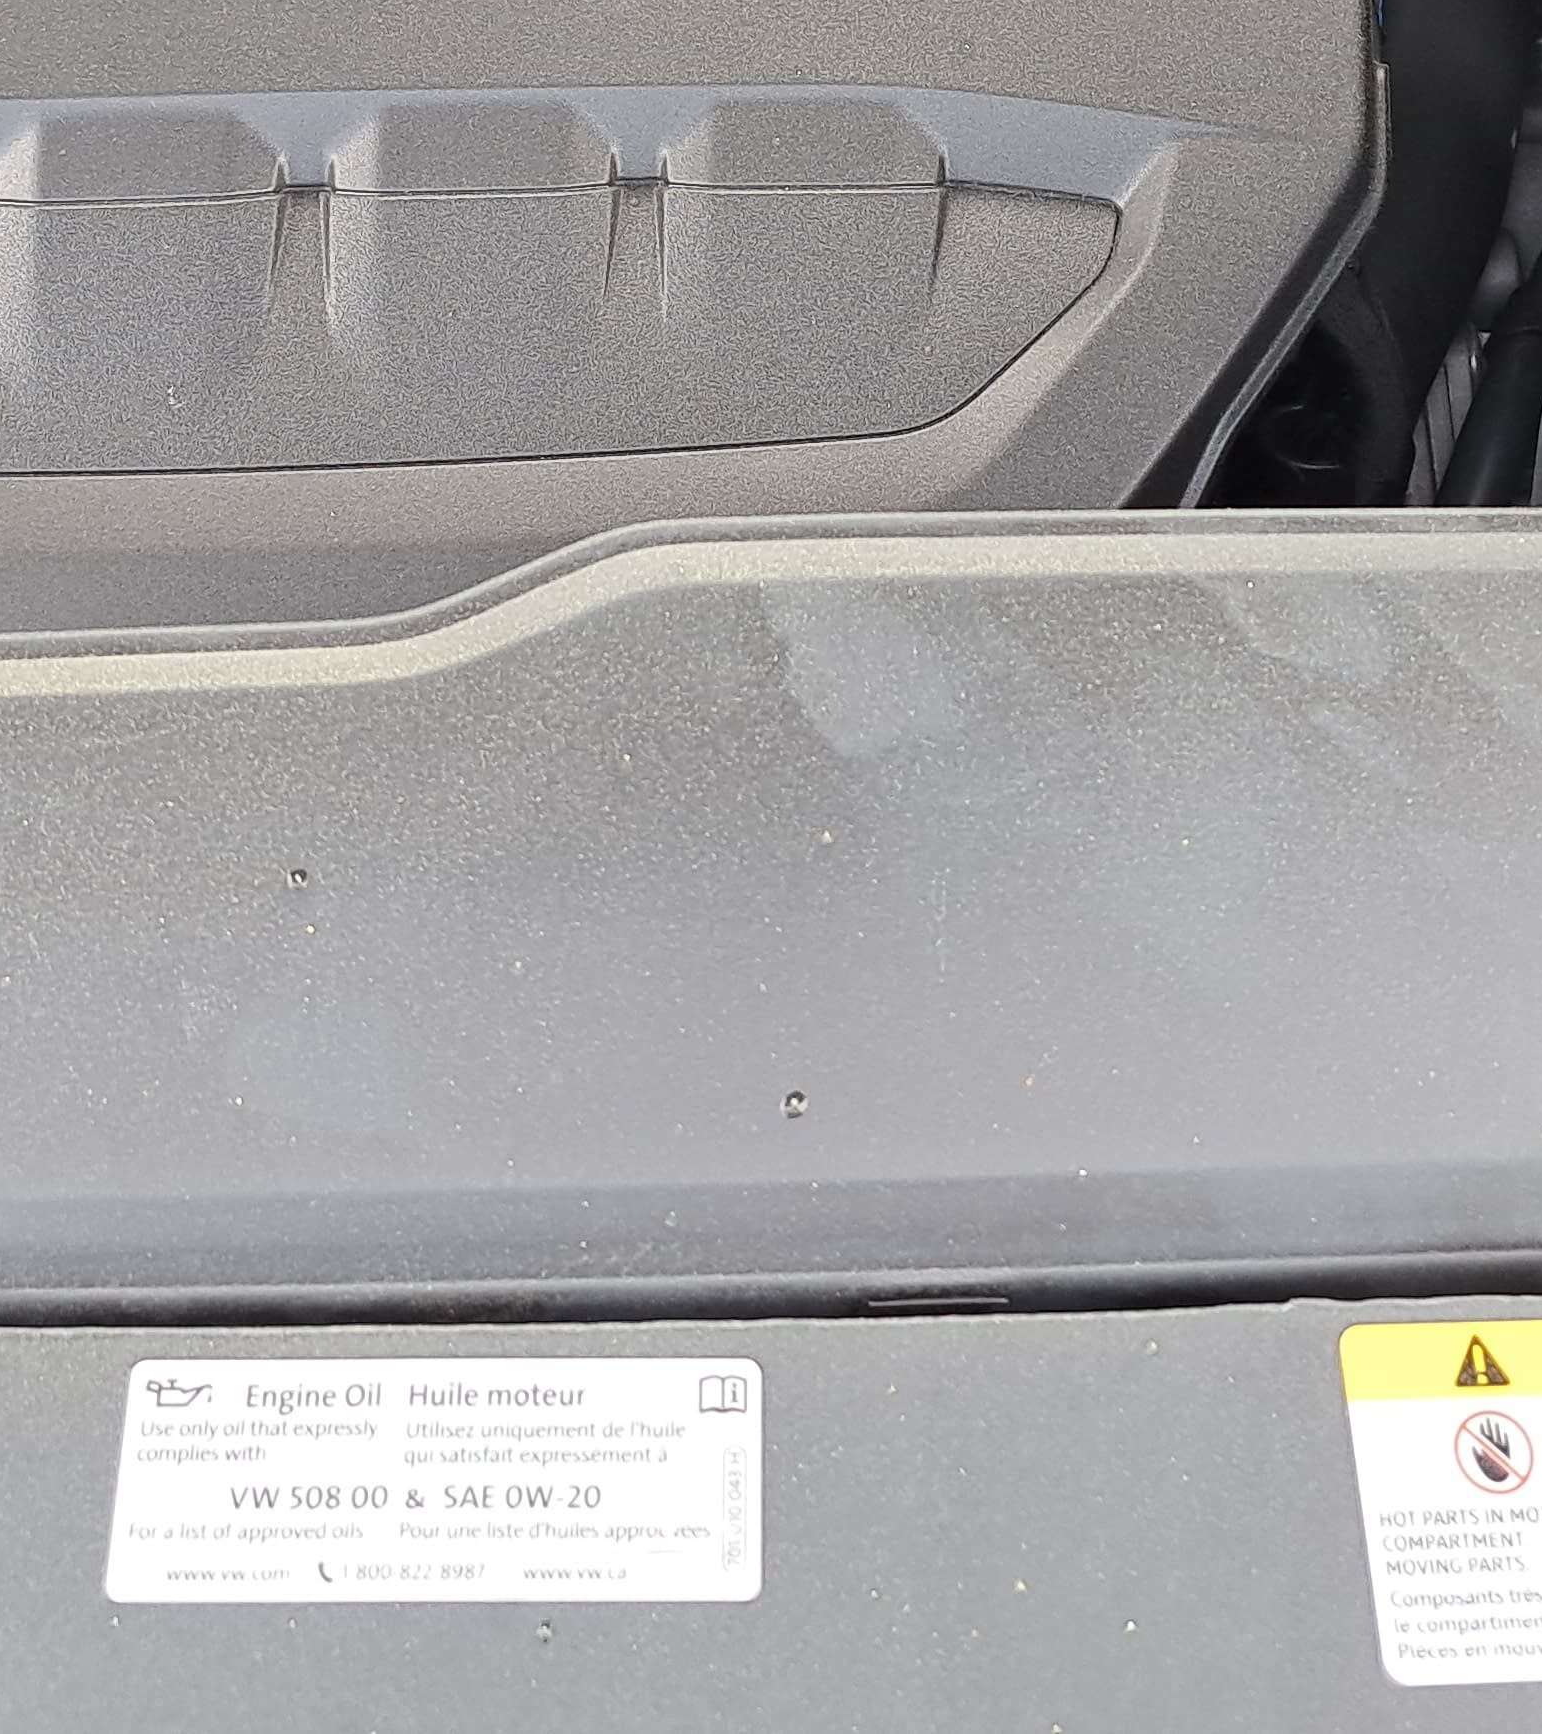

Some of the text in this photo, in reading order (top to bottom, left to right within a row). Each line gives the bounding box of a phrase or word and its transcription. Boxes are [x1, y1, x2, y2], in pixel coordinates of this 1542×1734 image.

[245, 1381, 382, 1417] Engine Oil
[408, 1381, 587, 1408] Huile moteur
[140, 1417, 379, 1443] Use only oil that expressly
[406, 1420, 687, 1443] Utilisez uniquement de l'huile
[136, 1443, 267, 1467] complies with
[403, 1449, 434, 1469] qui
[439, 1444, 514, 1464] satisfait
[229, 1485, 281, 1511] VW
[290, 1484, 342, 1511] 508
[350, 1484, 389, 1510] 00
[443, 1484, 495, 1510] SAE
[504, 1483, 602, 1510] 0W-20
[1379, 1510, 1416, 1529] HOT
[1421, 1508, 1480, 1527] PARTS
[1484, 1507, 1505, 1525] IN
[128, 1522, 156, 1541] For
[179, 1522, 207, 1541] list
[212, 1522, 232, 1541] of
[236, 1521, 327, 1545] approved
[331, 1521, 364, 1539] oils
[399, 1521, 440, 1540] Pour
[446, 1525, 482, 1540] une
[486, 1521, 525, 1539] liste
[528, 1521, 600, 1540] d'huiles
[1381, 1530, 1522, 1553] COMPARTMENT
[1385, 1557, 1464, 1577] MOVING
[1389, 1589, 1505, 1611] Composants
[1394, 1617, 1411, 1634] le
[1397, 1642, 1459, 1660] Pièces
[1463, 1644, 1487, 1658] en
